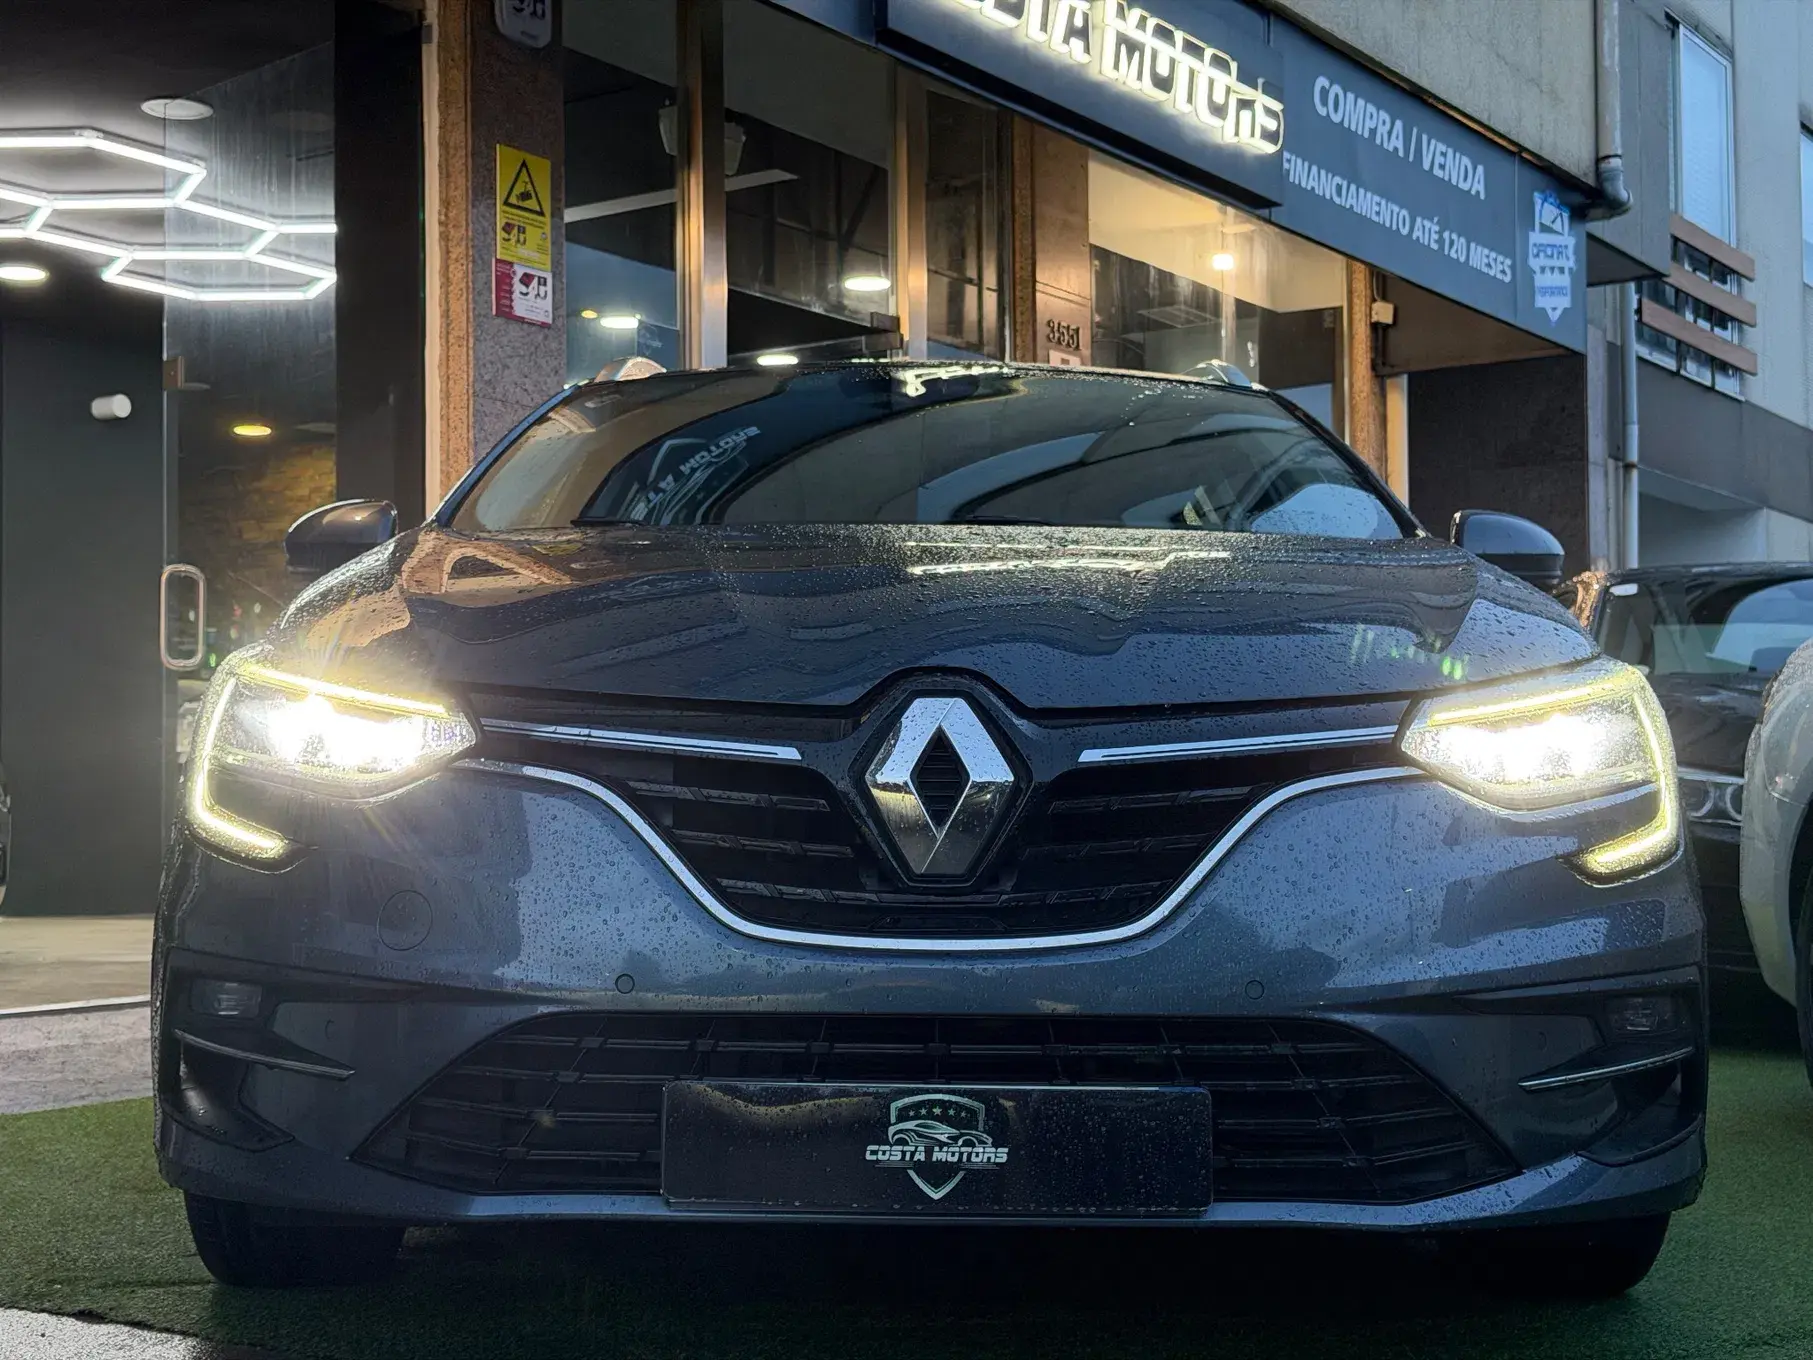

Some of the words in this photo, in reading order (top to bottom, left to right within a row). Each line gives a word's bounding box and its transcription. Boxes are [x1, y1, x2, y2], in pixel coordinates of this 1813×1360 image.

[1313, 75, 1405, 158] COMPRA
[1422, 133, 1486, 201] VENDA
[1283, 150, 1411, 236] FINANCIAMENTO
[1412, 216, 1440, 251] ATÉ
[1442, 229, 1467, 264] 120
[1469, 241, 1512, 284] MESES
[865, 1145, 926, 1162] COSTA
[932, 1146, 1009, 1163] MOTORS
